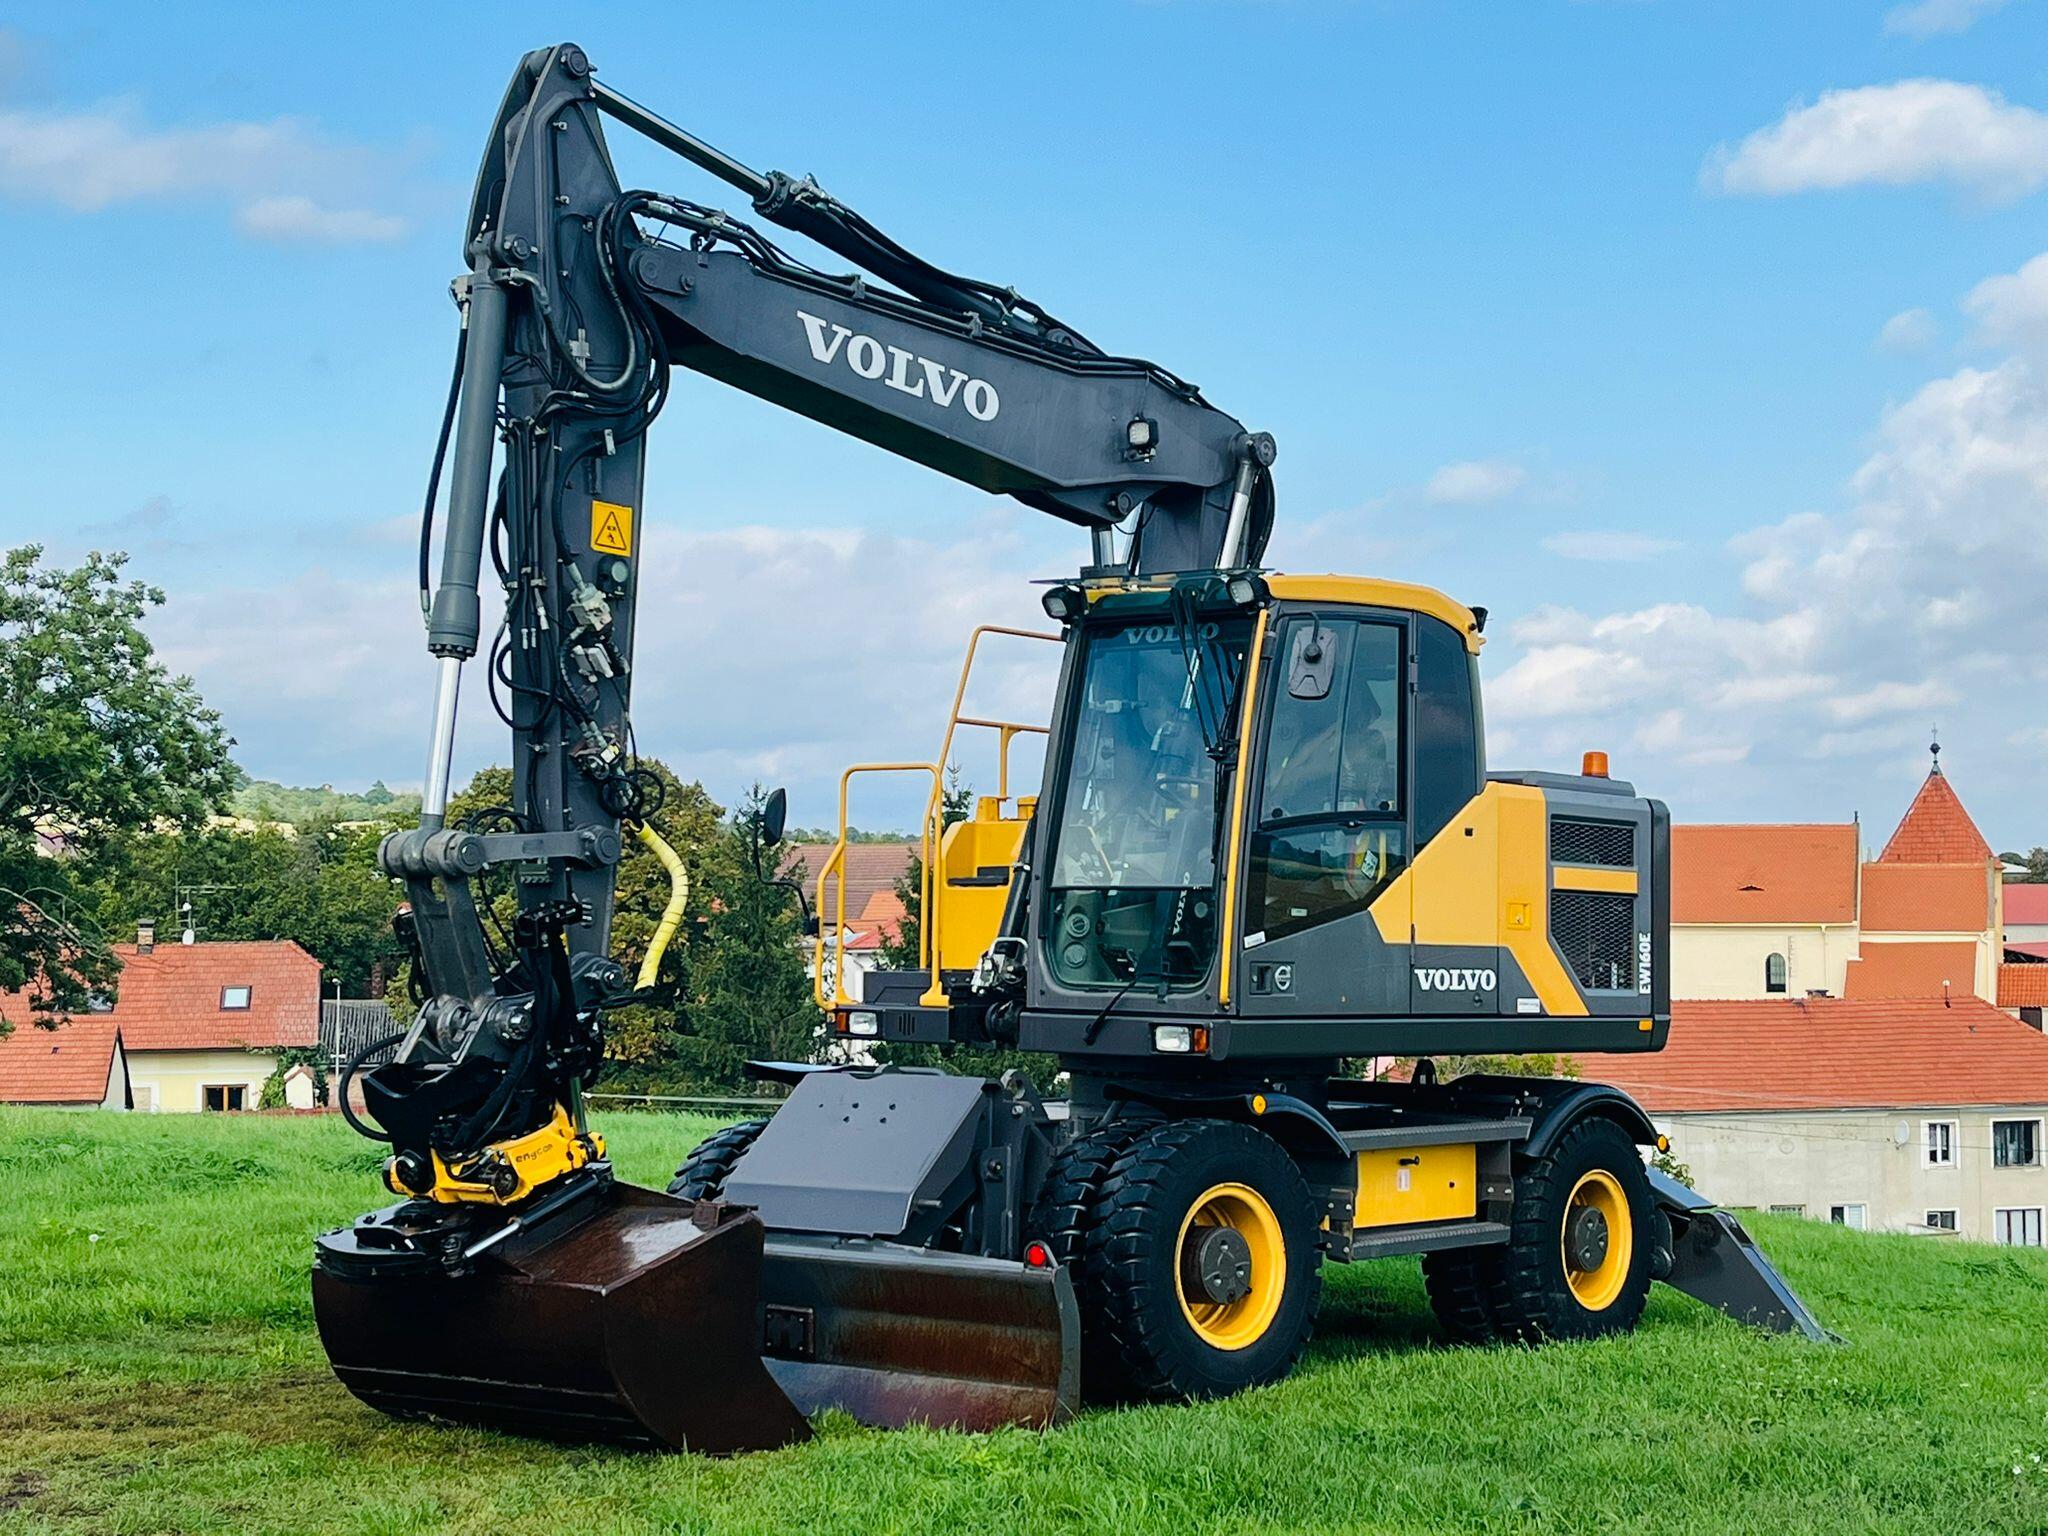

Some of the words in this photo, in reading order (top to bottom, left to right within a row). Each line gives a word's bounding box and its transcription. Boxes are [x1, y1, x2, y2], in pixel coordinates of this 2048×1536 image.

[797, 310, 1000, 422] VOLVO
[1414, 968, 1497, 991] VOLVO
[1638, 932, 1652, 994] EW160E
